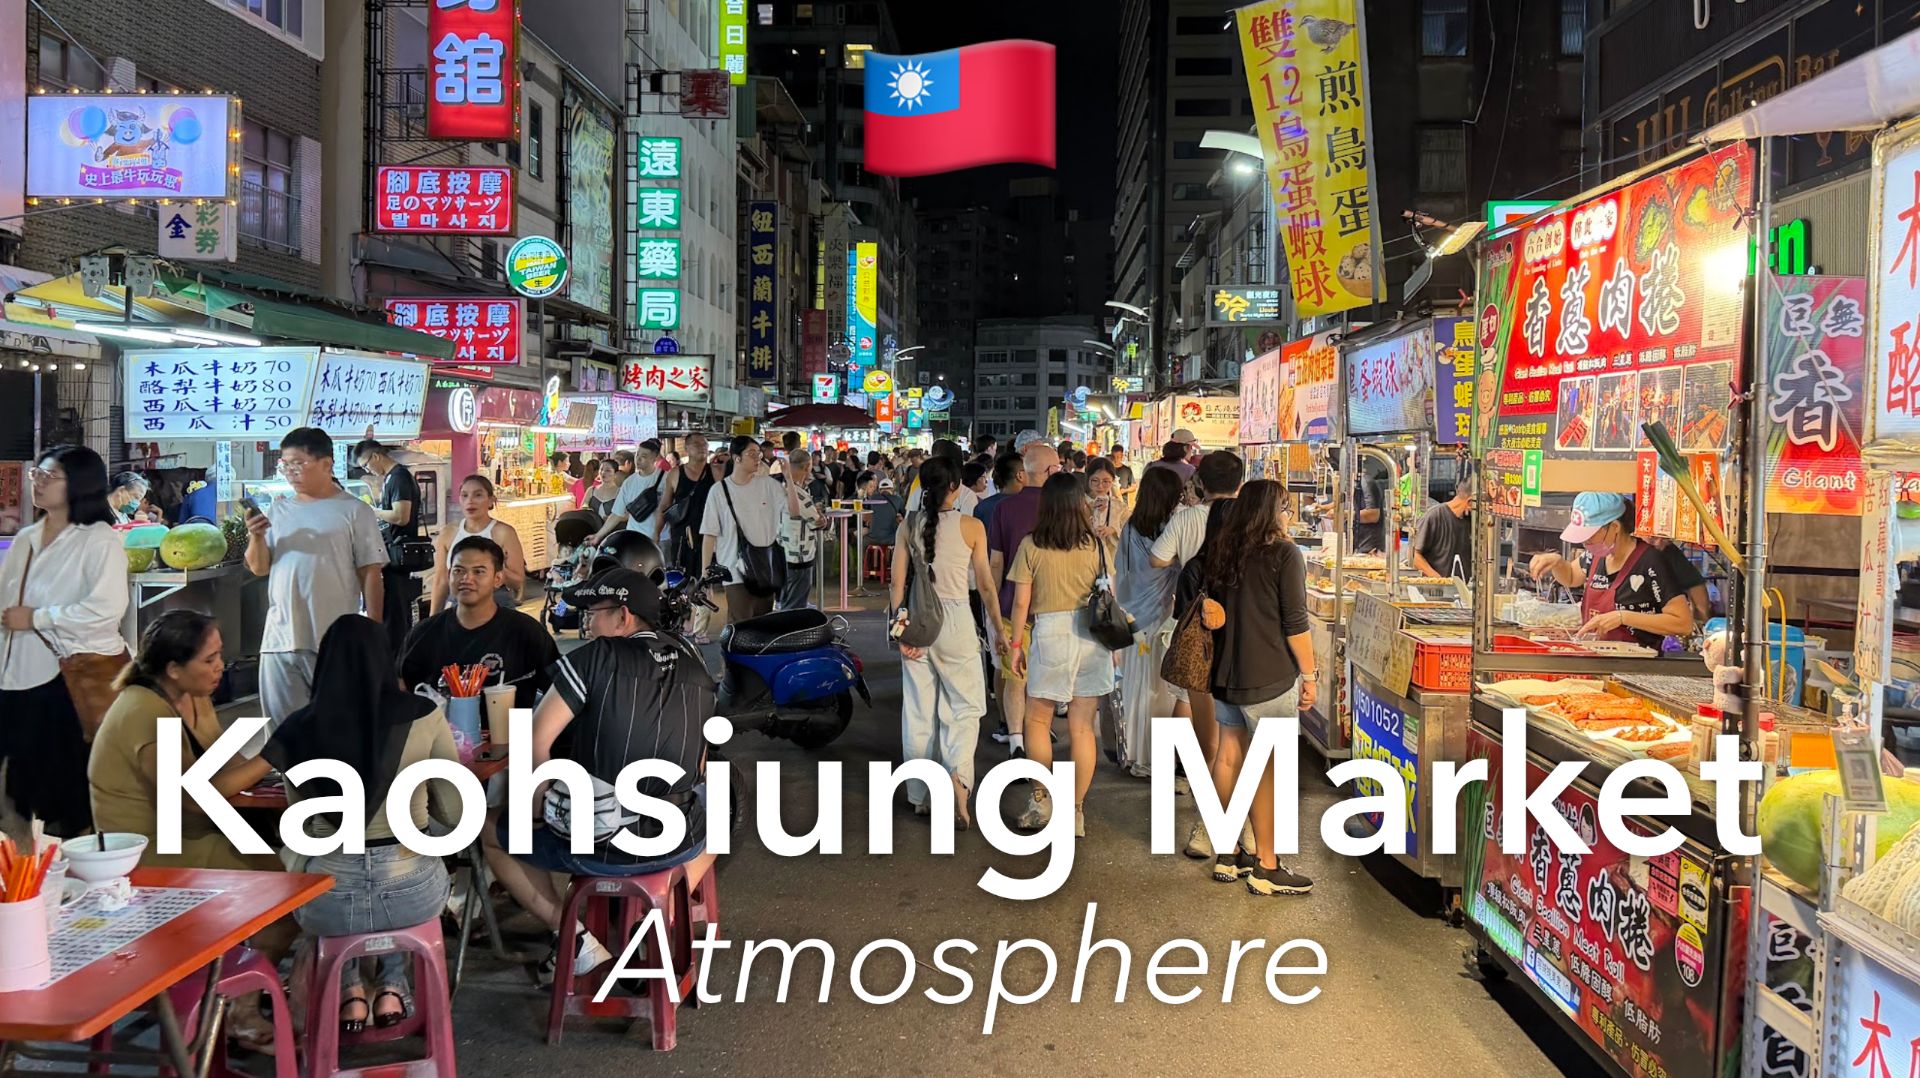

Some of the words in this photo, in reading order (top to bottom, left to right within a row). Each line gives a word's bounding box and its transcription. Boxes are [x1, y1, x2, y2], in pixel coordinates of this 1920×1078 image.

[1315, 60, 1371, 238] 煎鳥蛋
[386, 170, 502, 196] 腳底按摩
[640, 139, 680, 327] 遠東藥局
[751, 208, 774, 372] 紐西蘭牛排
[143, 358, 258, 377] 木瓜牛奶
[264, 359, 292, 373] 70
[621, 362, 710, 393] 烤肉之家
[139, 377, 258, 396] 酪梨牛奶
[261, 379, 292, 393] 80
[143, 396, 258, 412] 西瓜牛奶
[264, 396, 292, 411] 70
[143, 413, 253, 431] 西瓜汁
[264, 414, 292, 428] 50
[1782, 467, 1857, 490] Giant
[1509, 872, 1533, 908] Giant
[1535, 894, 1570, 940] Scallion
[1573, 926, 1601, 965] Meat
[1604, 948, 1626, 984] Roll
[1624, 996, 1662, 1045] 低脂肪
